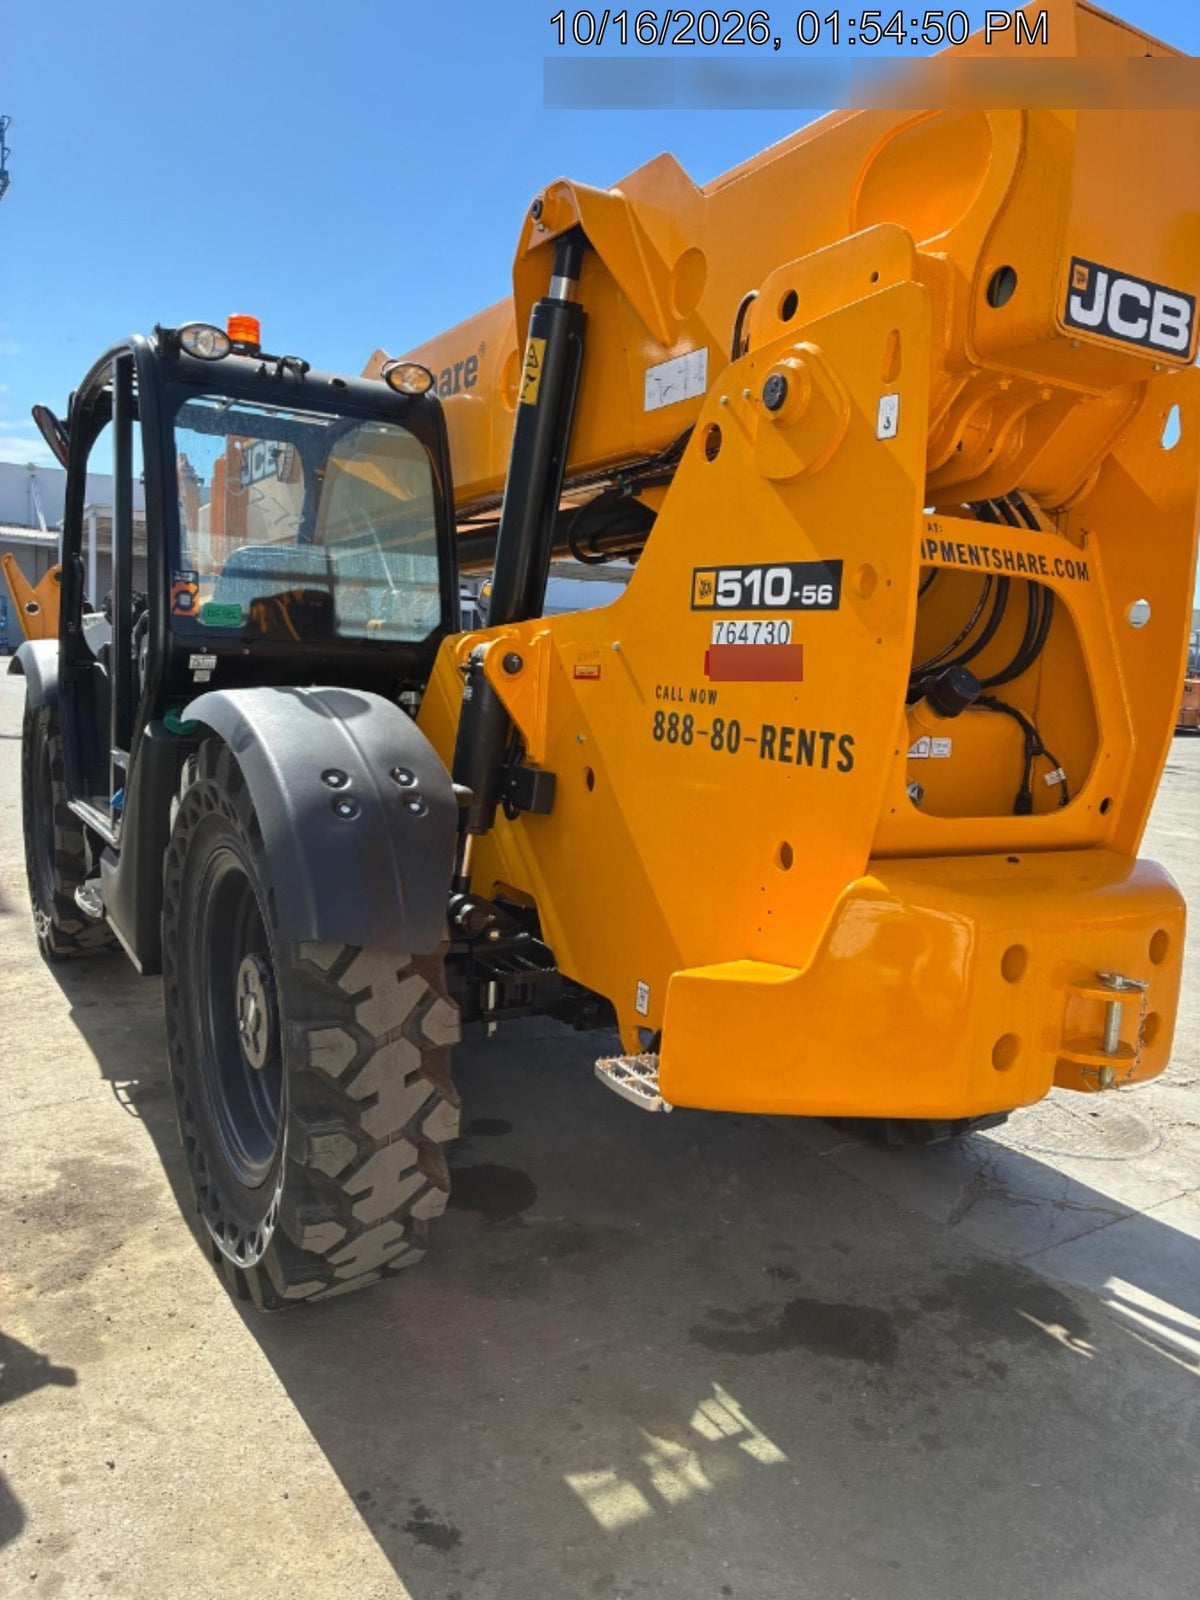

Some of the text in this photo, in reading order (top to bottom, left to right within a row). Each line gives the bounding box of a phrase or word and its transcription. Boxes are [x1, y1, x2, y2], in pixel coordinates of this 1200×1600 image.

[1069, 270, 1191, 352] JCB
[714, 621, 790, 645] 764730
[655, 684, 718, 706] CALL NOW
[653, 710, 856, 773] 888-80-RENTS
